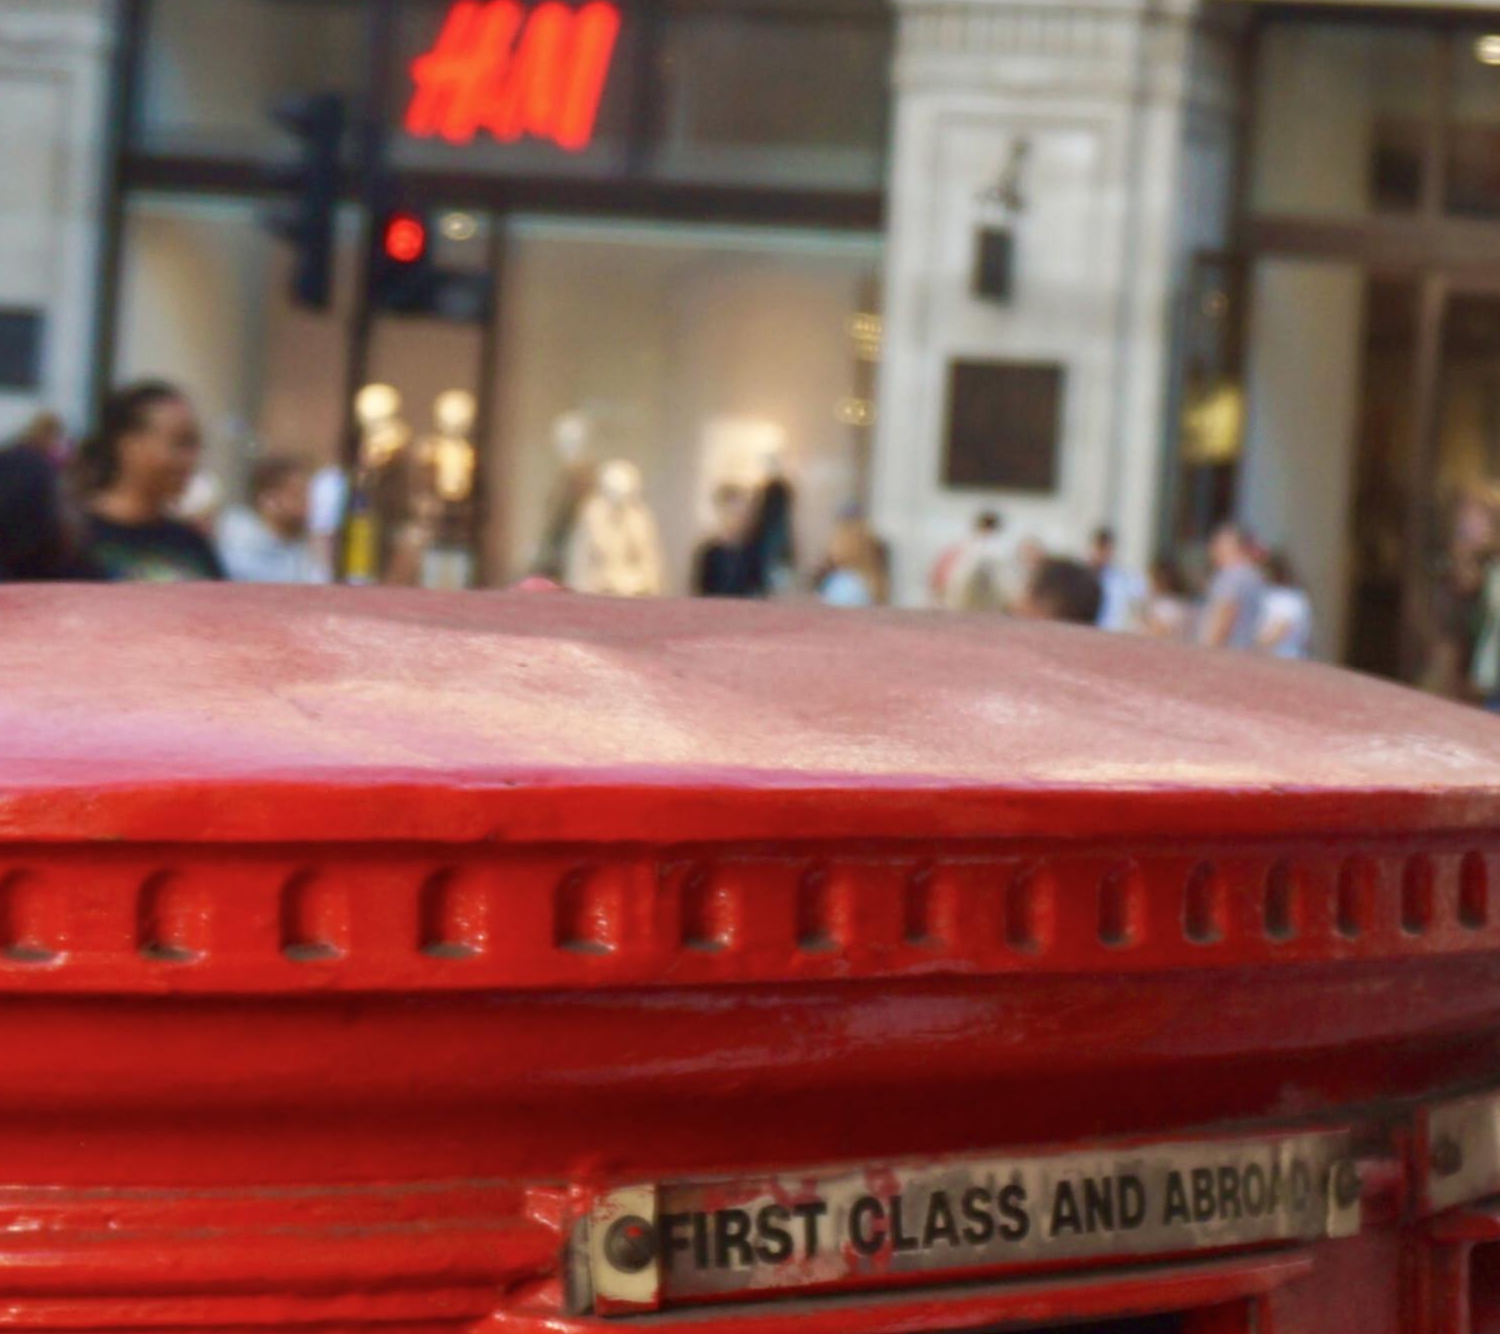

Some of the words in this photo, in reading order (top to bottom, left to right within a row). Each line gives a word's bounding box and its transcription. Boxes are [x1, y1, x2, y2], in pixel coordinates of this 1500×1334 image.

[658, 1201, 827, 1270] FIRST
[848, 1185, 1034, 1257] CLASS
[1049, 1175, 1147, 1233] AND
